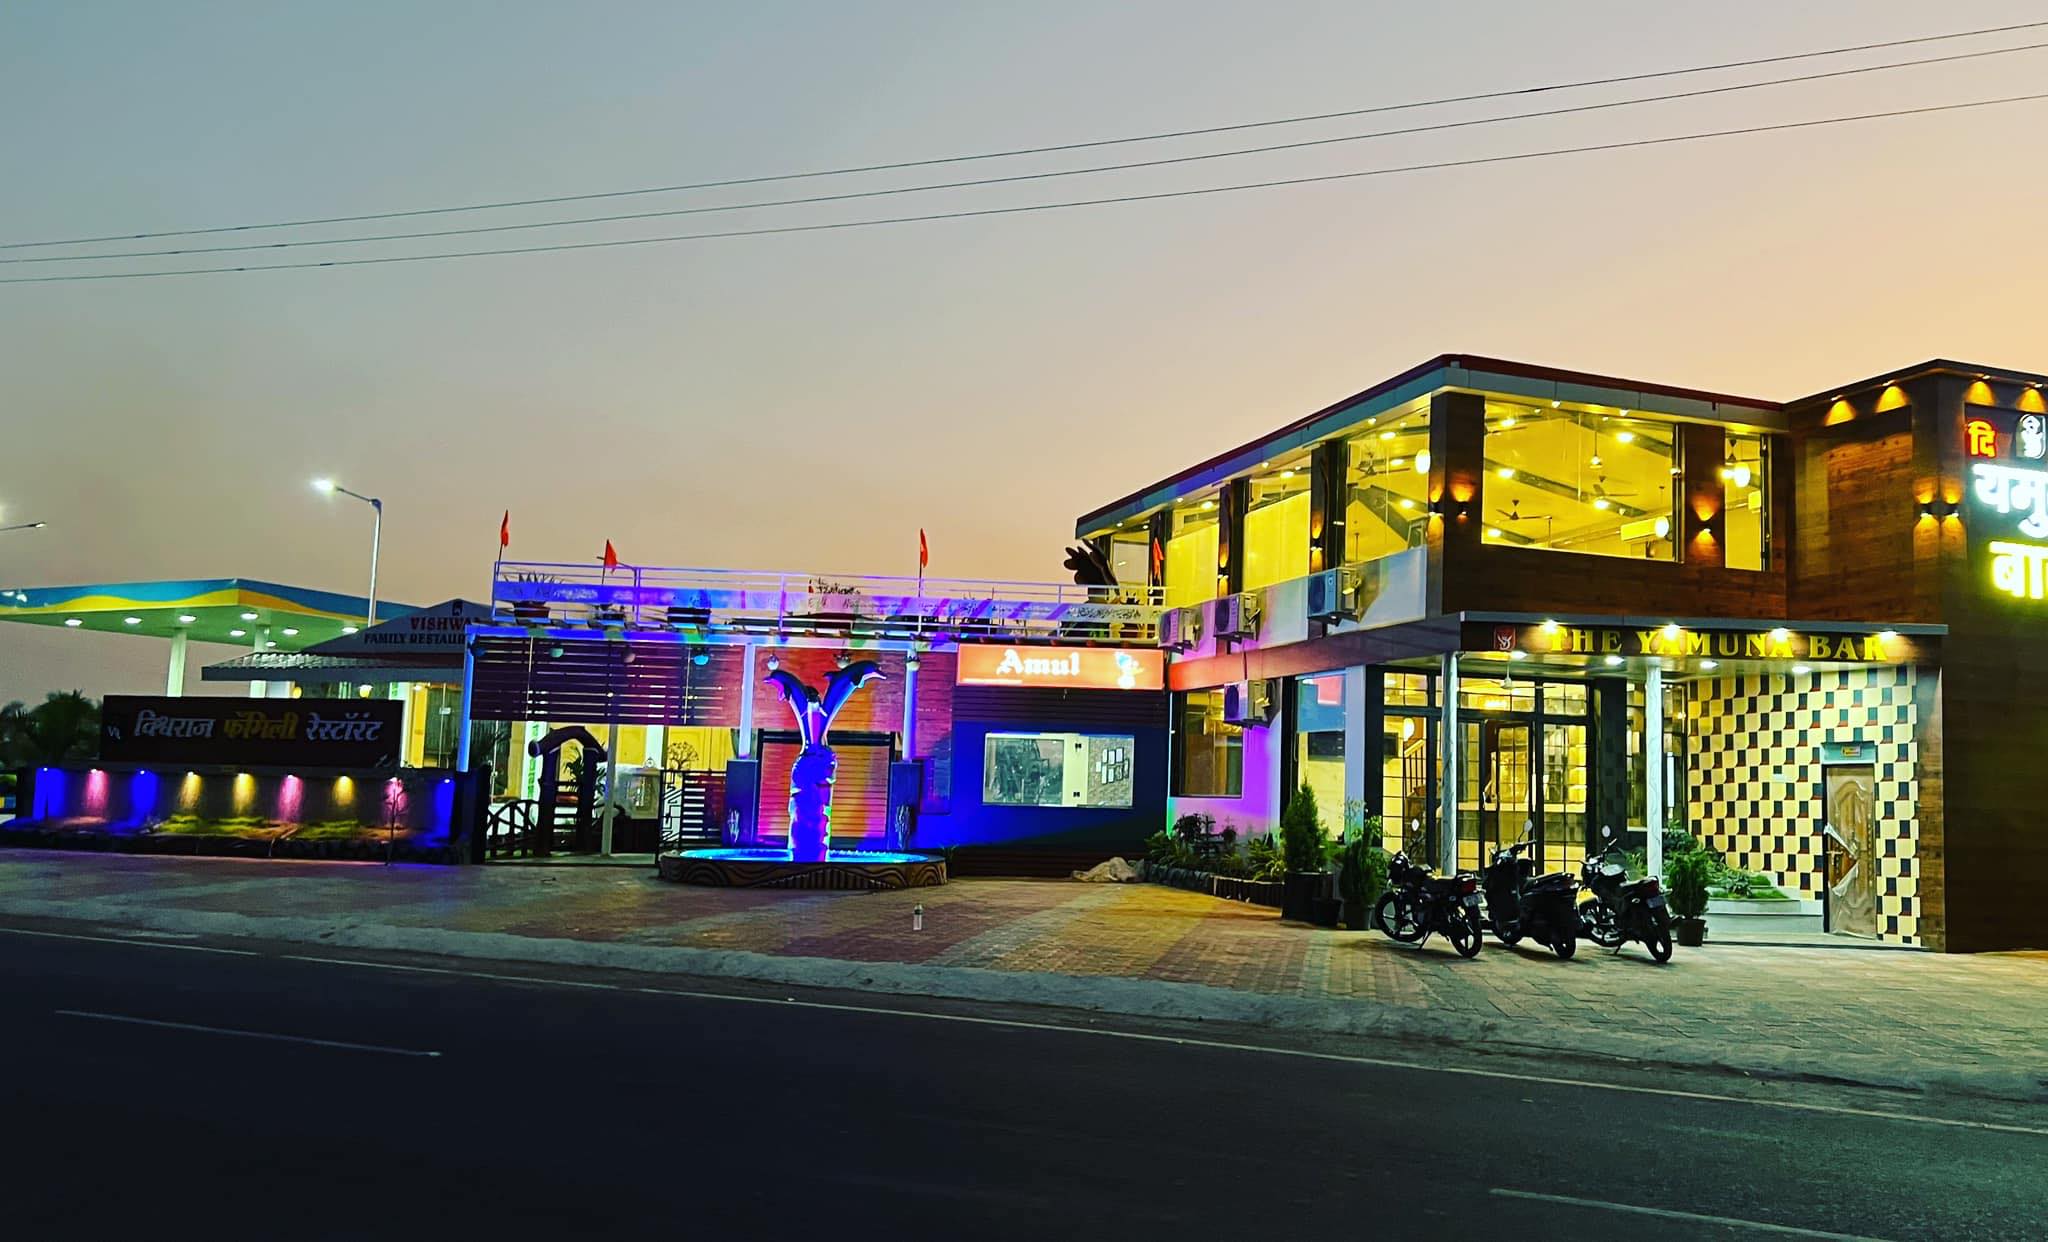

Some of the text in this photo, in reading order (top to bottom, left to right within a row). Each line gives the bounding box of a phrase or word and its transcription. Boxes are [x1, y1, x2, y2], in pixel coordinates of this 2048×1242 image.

[1971, 463, 2048, 538] यमु
[1989, 540, 2048, 599] बा
[364, 632, 466, 645] FAMILY RESTAUR
[1546, 626, 1889, 661] THE YAMUNA BAR
[996, 648, 1081, 676] Amul
